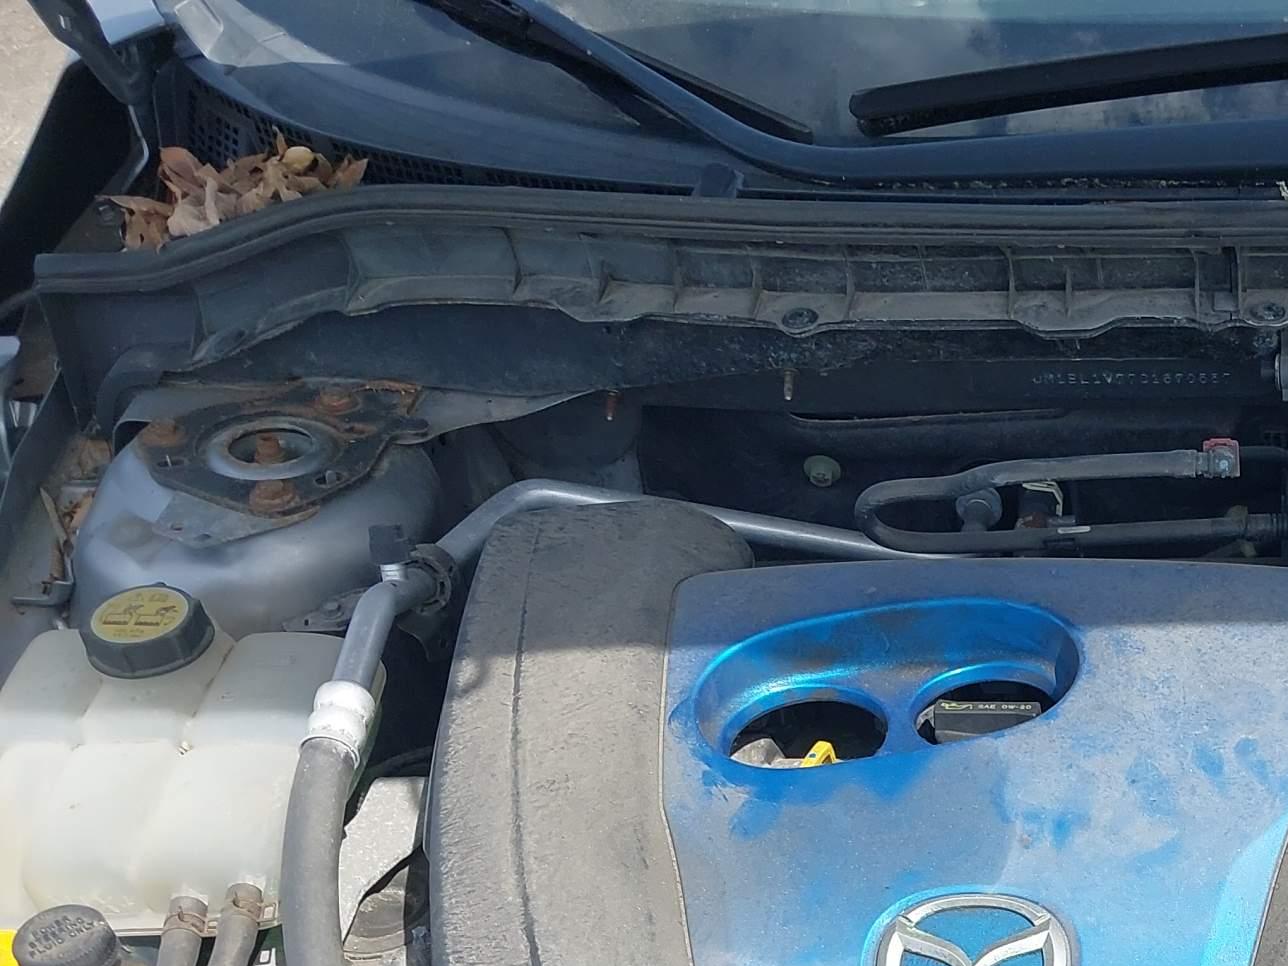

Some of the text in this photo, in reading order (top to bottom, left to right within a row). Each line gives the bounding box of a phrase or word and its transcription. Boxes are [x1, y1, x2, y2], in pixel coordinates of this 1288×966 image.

[28, 916, 85, 949] STEERING
[29, 920, 96, 958] FLUID ONLY
[31, 915, 72, 939] POWER
